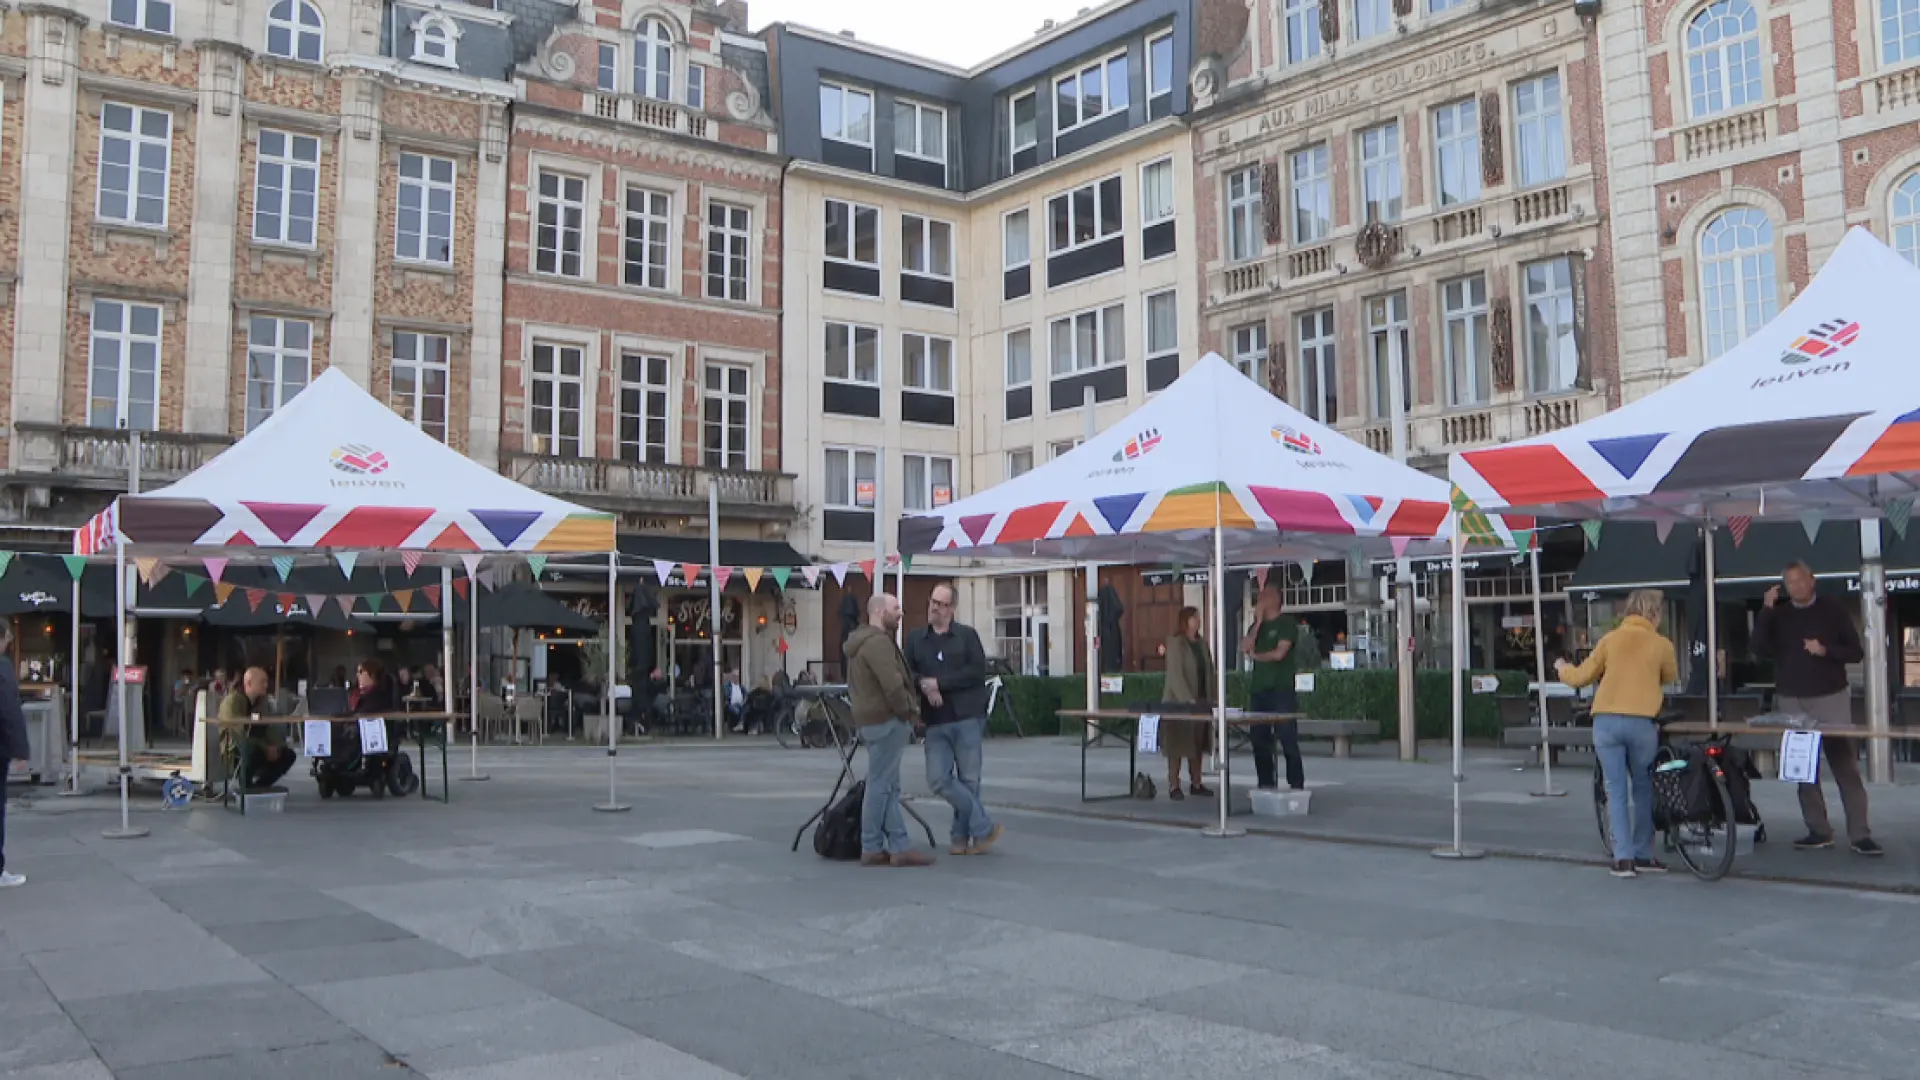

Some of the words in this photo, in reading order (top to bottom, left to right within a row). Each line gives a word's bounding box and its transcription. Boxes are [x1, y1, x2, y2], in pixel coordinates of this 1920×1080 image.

[1258, 104, 1294, 132] AUX
[1304, 84, 1359, 117] MILLE
[1750, 361, 1851, 389] leuven
